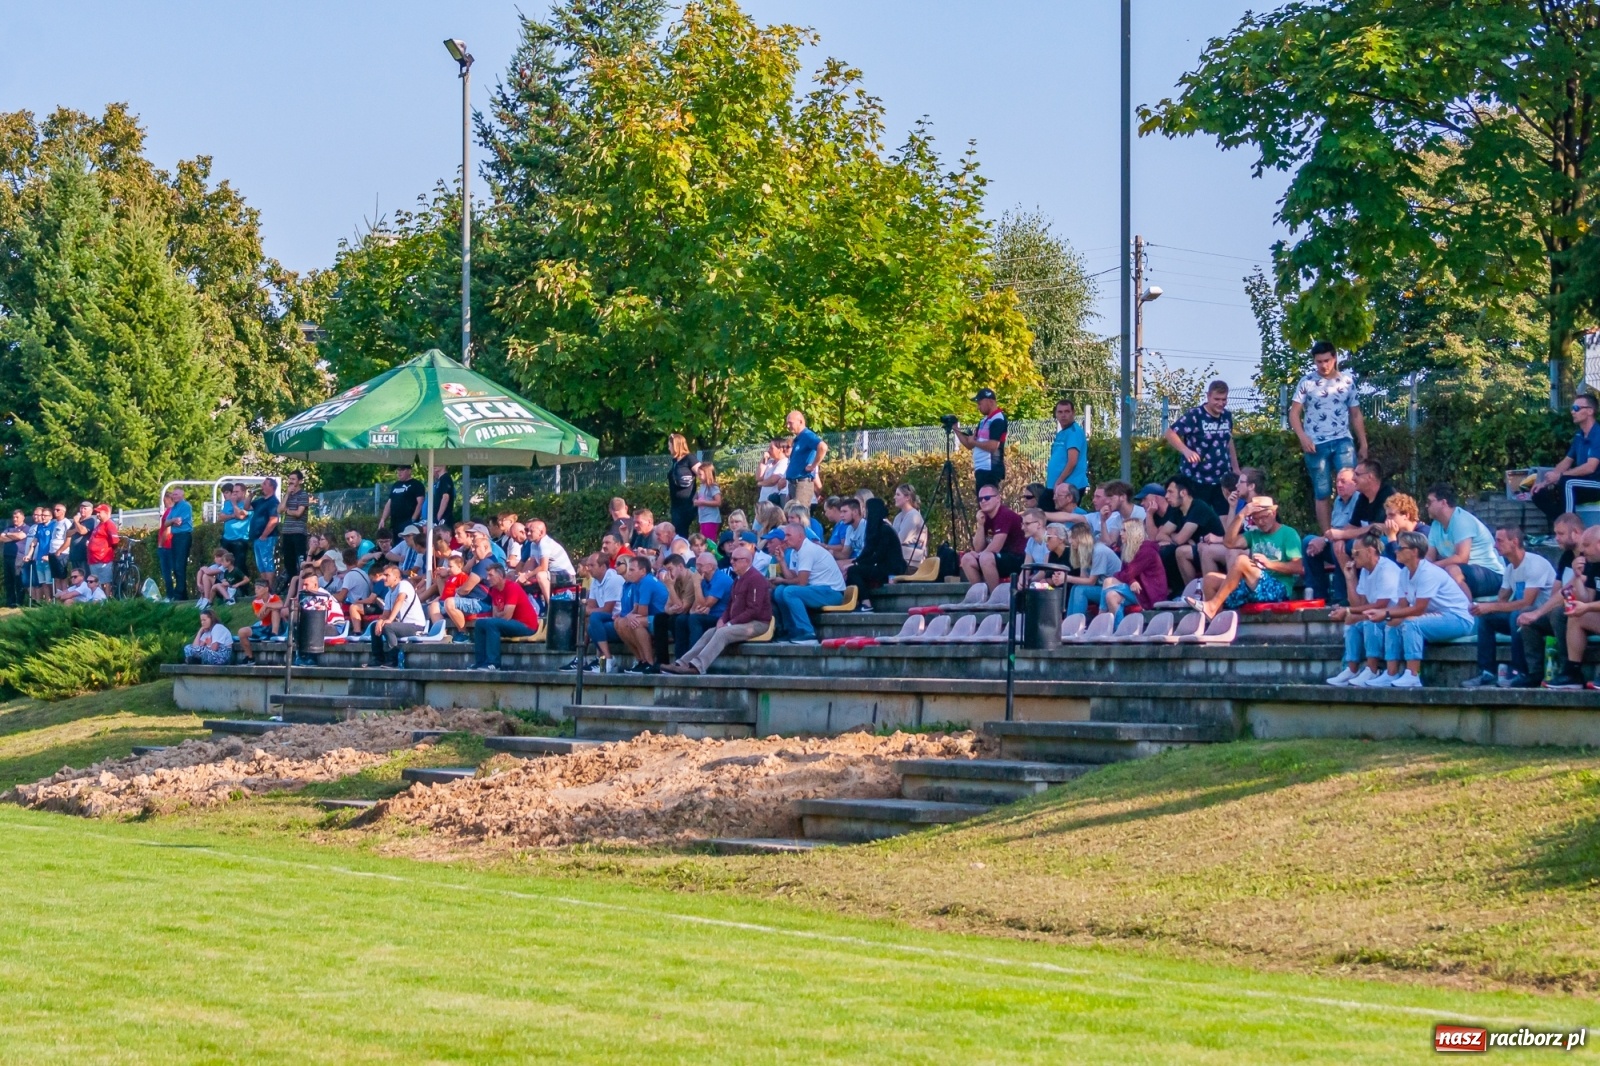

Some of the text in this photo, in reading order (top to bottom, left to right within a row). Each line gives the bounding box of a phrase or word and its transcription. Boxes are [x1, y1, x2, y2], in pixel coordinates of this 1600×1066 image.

[443, 401, 535, 424] LECH
[277, 422, 318, 447] PREMIUM
[372, 434, 395, 443] LECH
[475, 424, 537, 443] PREMIUM
